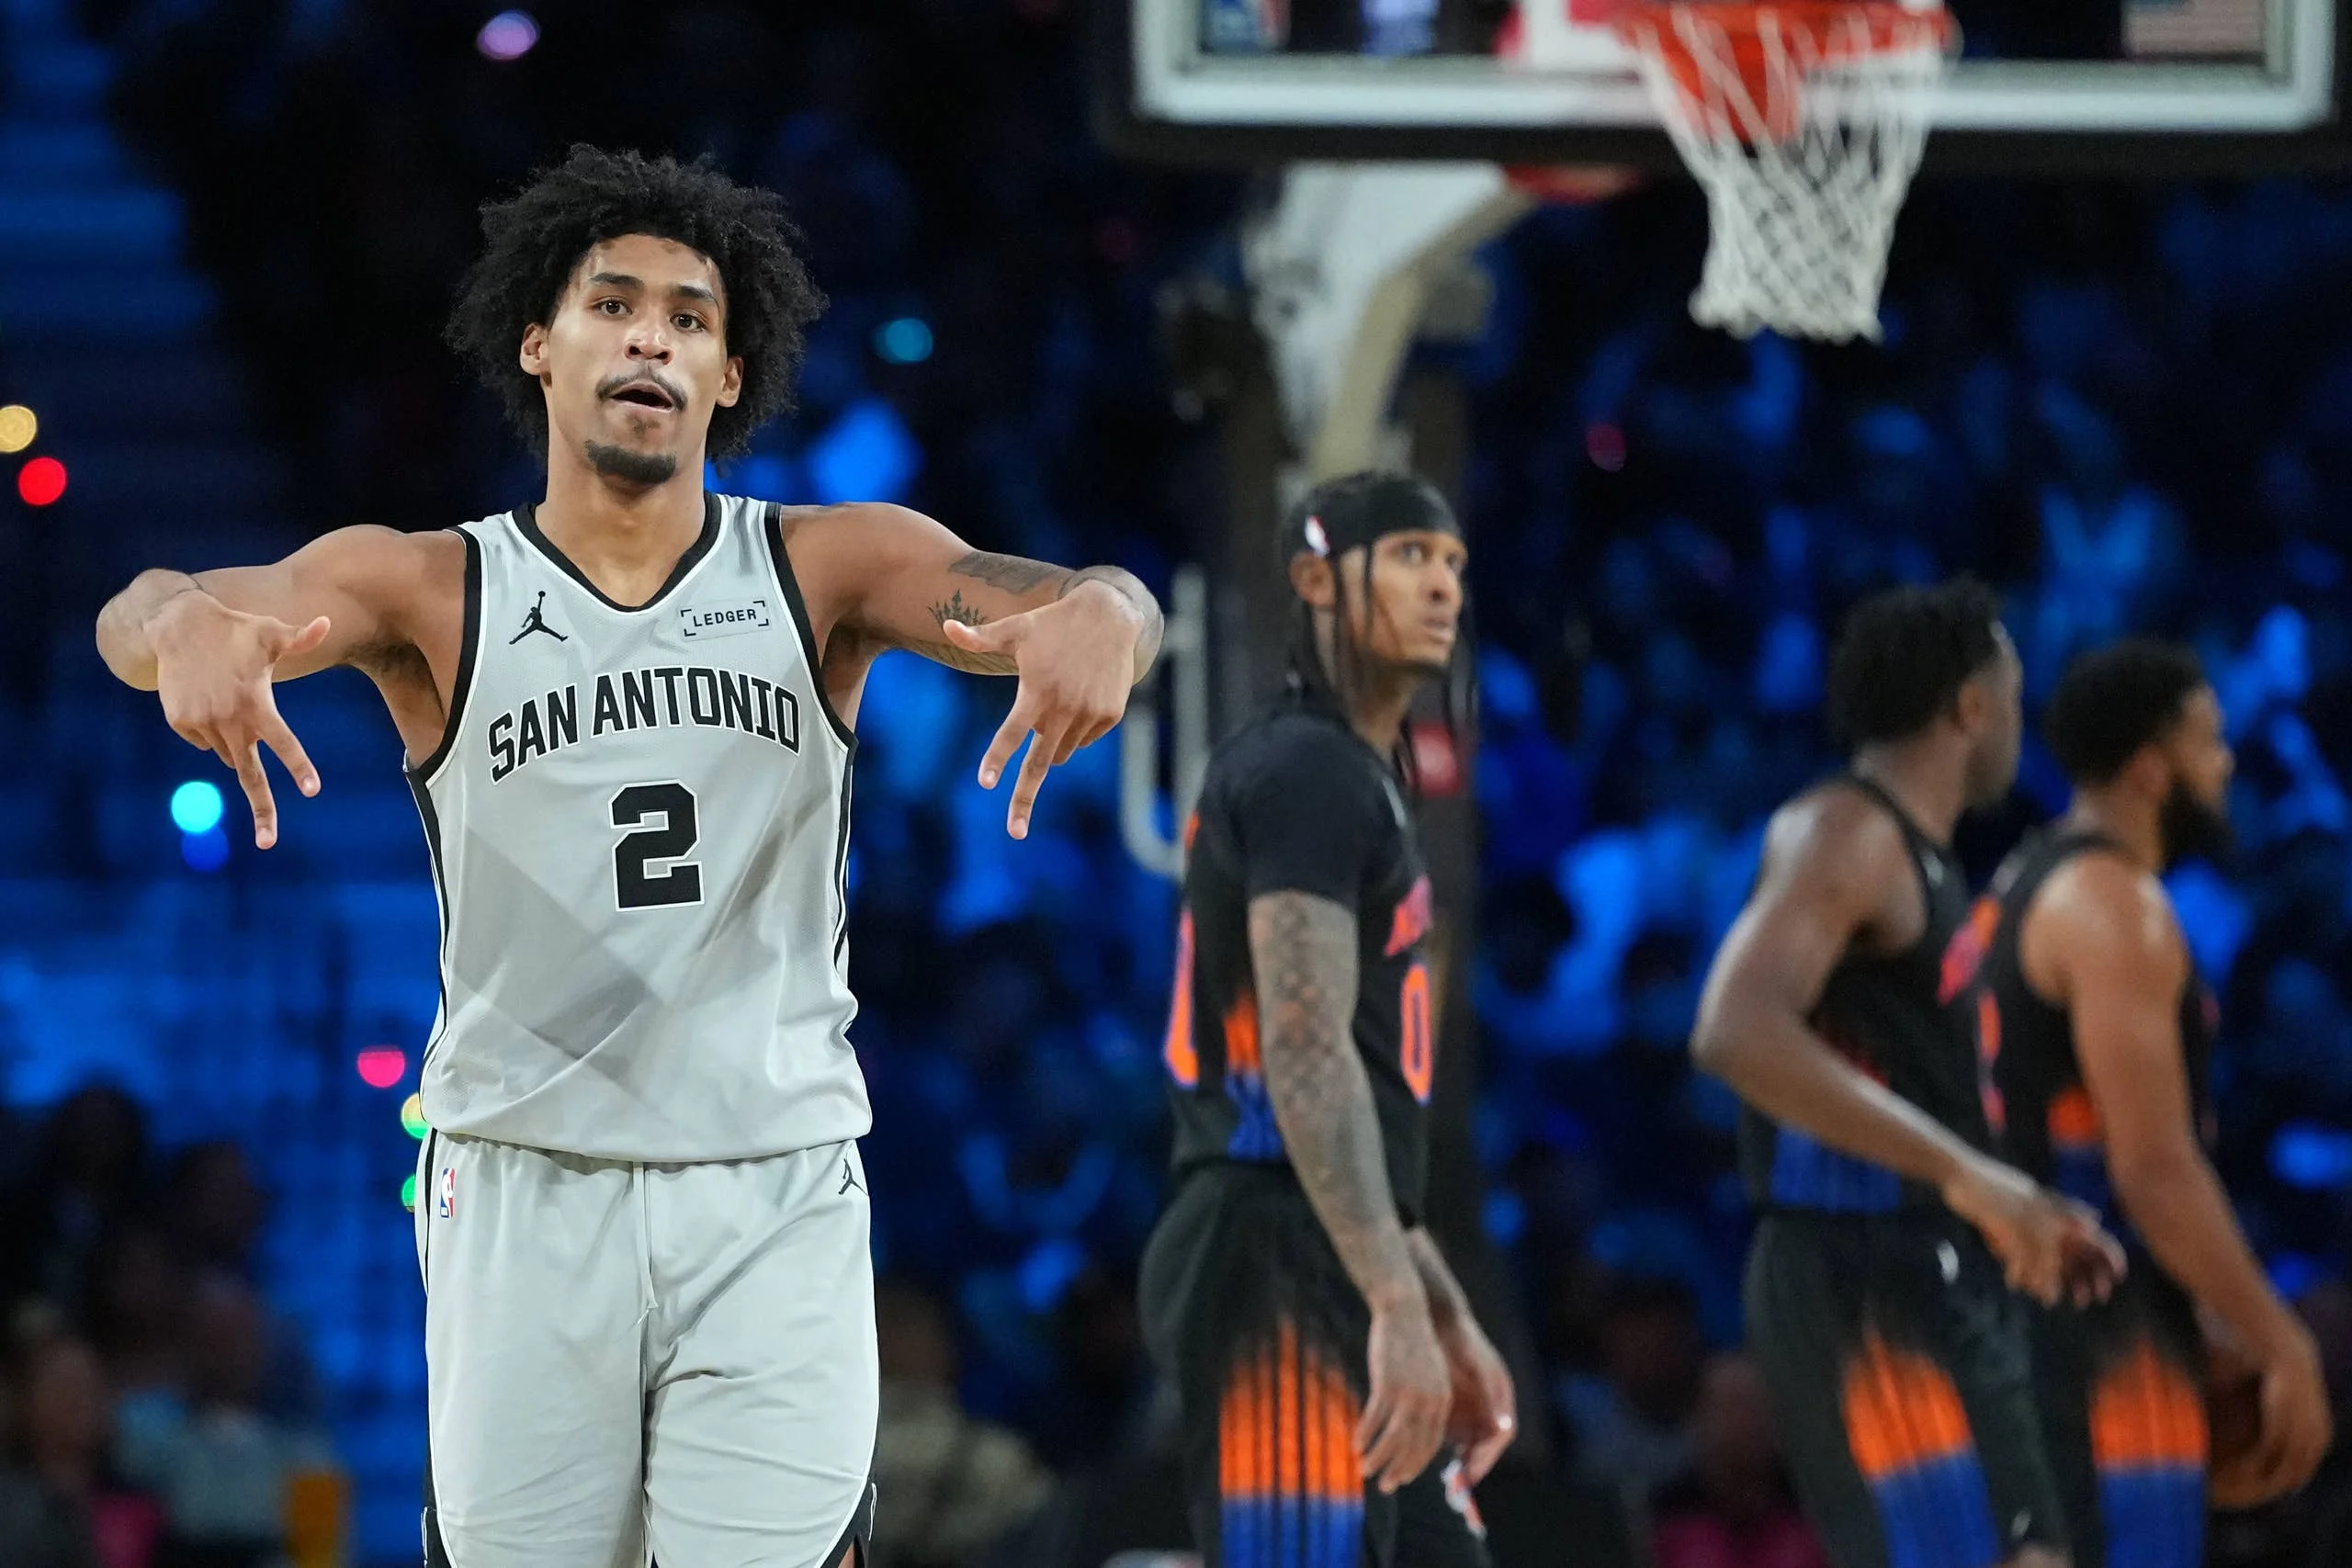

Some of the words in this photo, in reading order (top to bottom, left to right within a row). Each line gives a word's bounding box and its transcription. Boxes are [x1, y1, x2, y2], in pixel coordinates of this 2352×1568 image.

[693, 608, 757, 626] LEDGER
[488, 682, 579, 785] SAN
[591, 665, 800, 756] ANTONIO
[608, 779, 704, 911] 2
[1400, 963, 1433, 1105] 0
